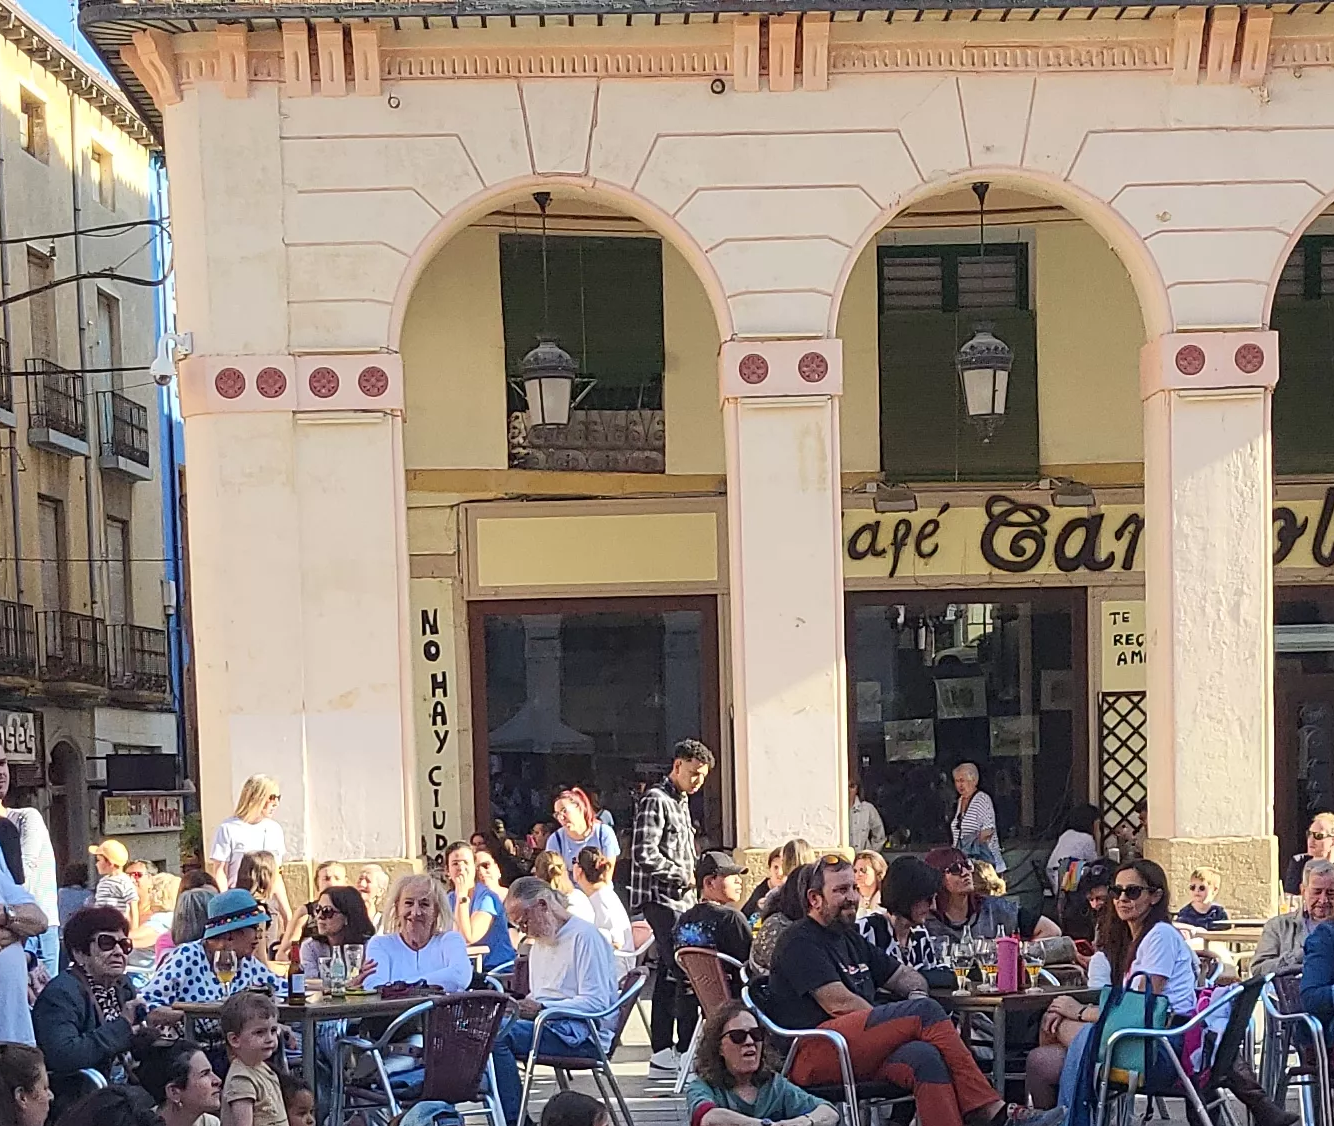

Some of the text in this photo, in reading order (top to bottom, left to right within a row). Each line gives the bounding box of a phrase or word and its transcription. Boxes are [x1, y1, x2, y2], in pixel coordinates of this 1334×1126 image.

[841, 502, 950, 577] afé
[421, 609, 441, 662] NO
[1109, 611, 1131, 626] TE
[430, 671, 449, 754] HAY
